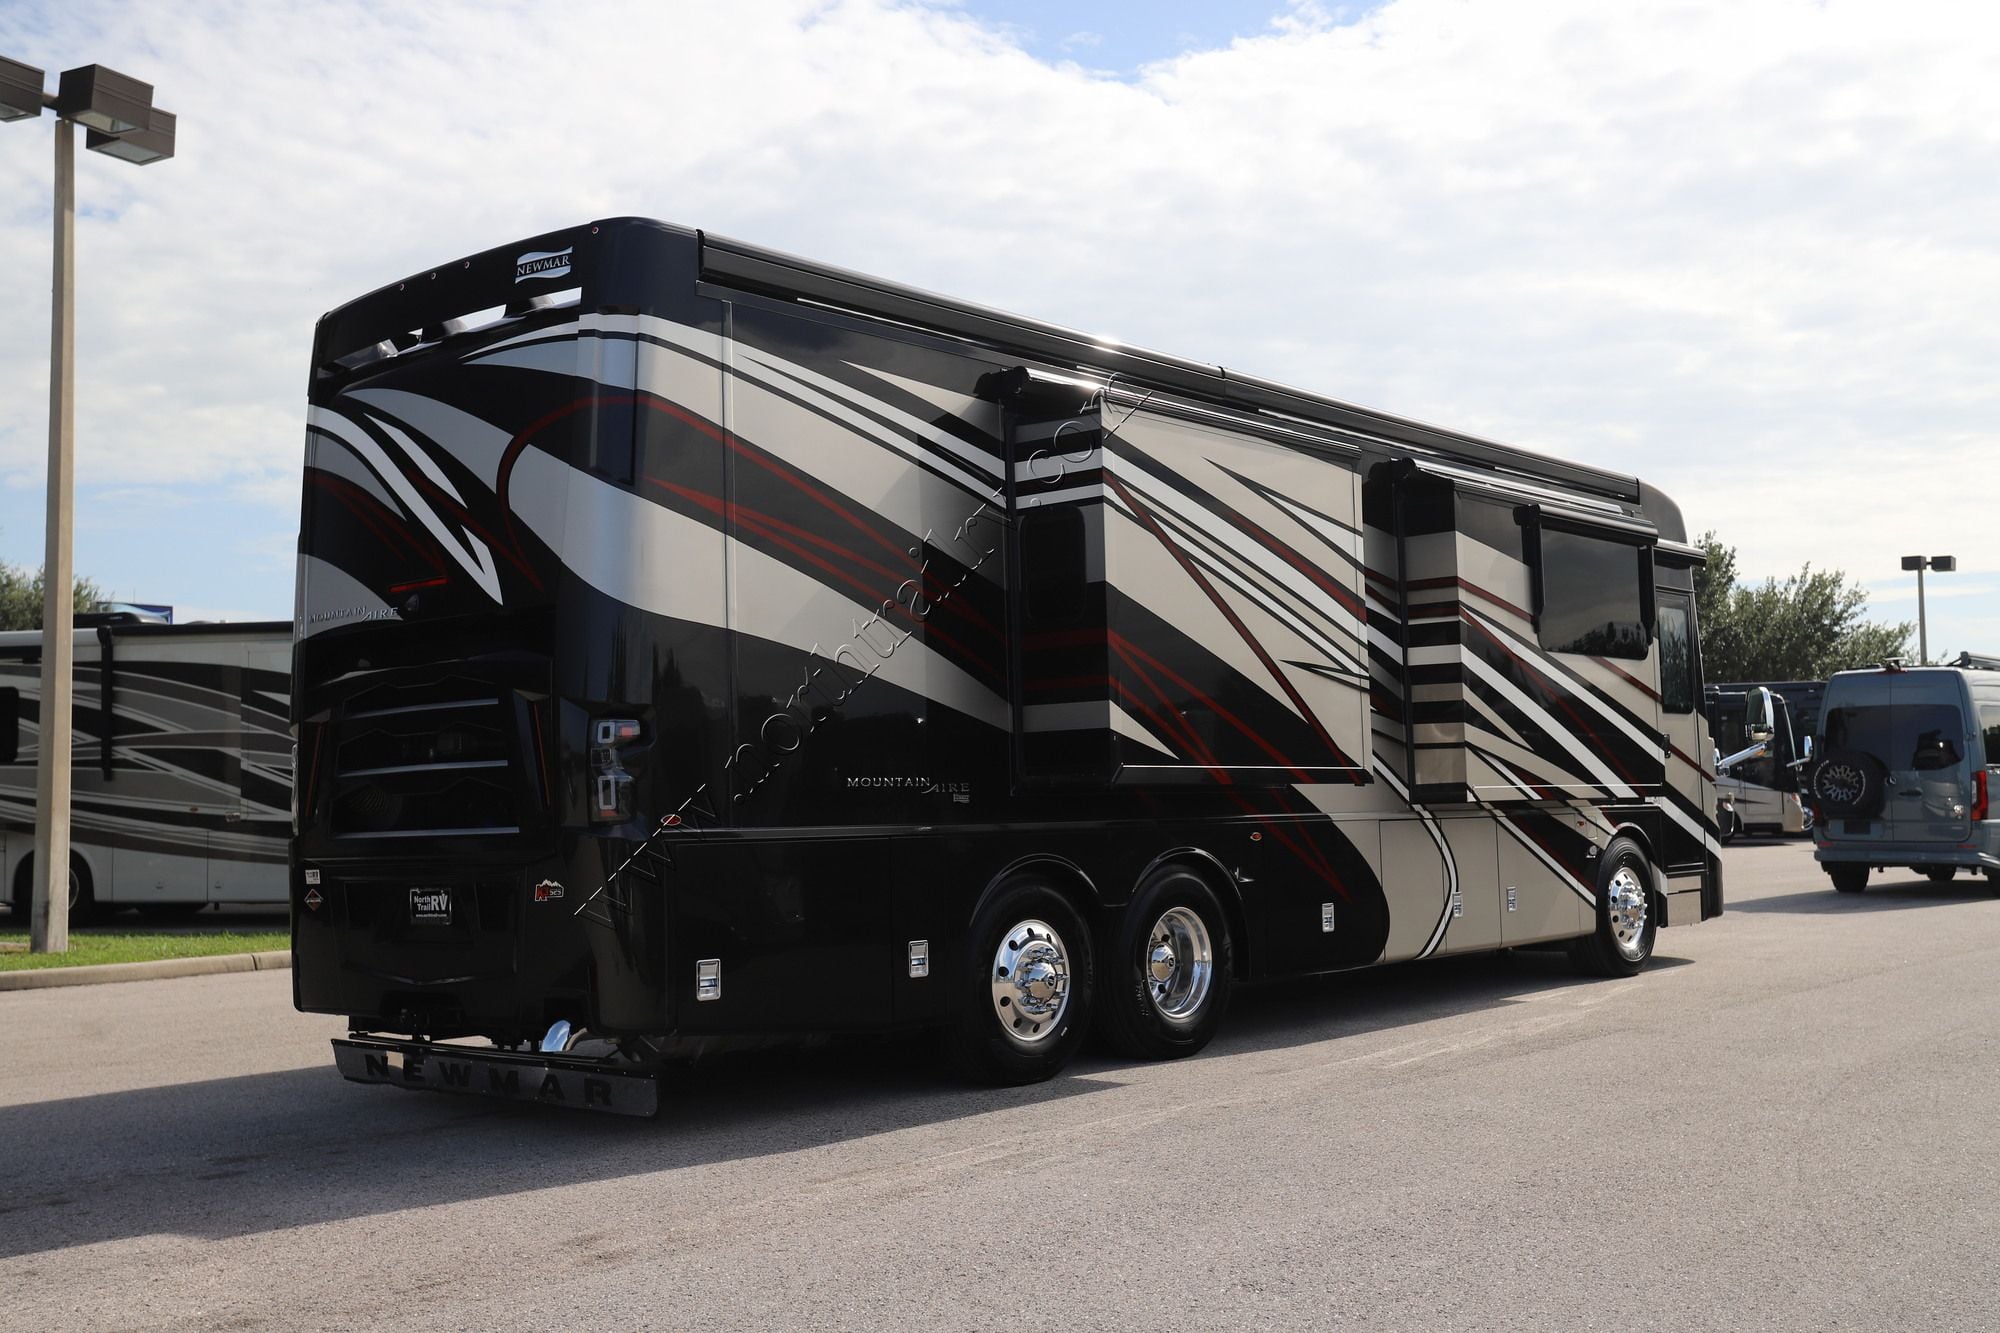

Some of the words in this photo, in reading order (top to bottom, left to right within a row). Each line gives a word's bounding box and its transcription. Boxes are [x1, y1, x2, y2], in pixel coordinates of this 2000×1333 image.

[516, 255, 571, 277] NEWMAR
[309, 605, 367, 624] MOUNTAIN
[361, 606, 399, 621] AIRE
[847, 777, 930, 787] MOUNTAIN
[921, 782, 970, 794] AIRE
[413, 895, 431, 904] North
[431, 895, 449, 911] RV
[364, 1053, 613, 1107] NEWMAR
